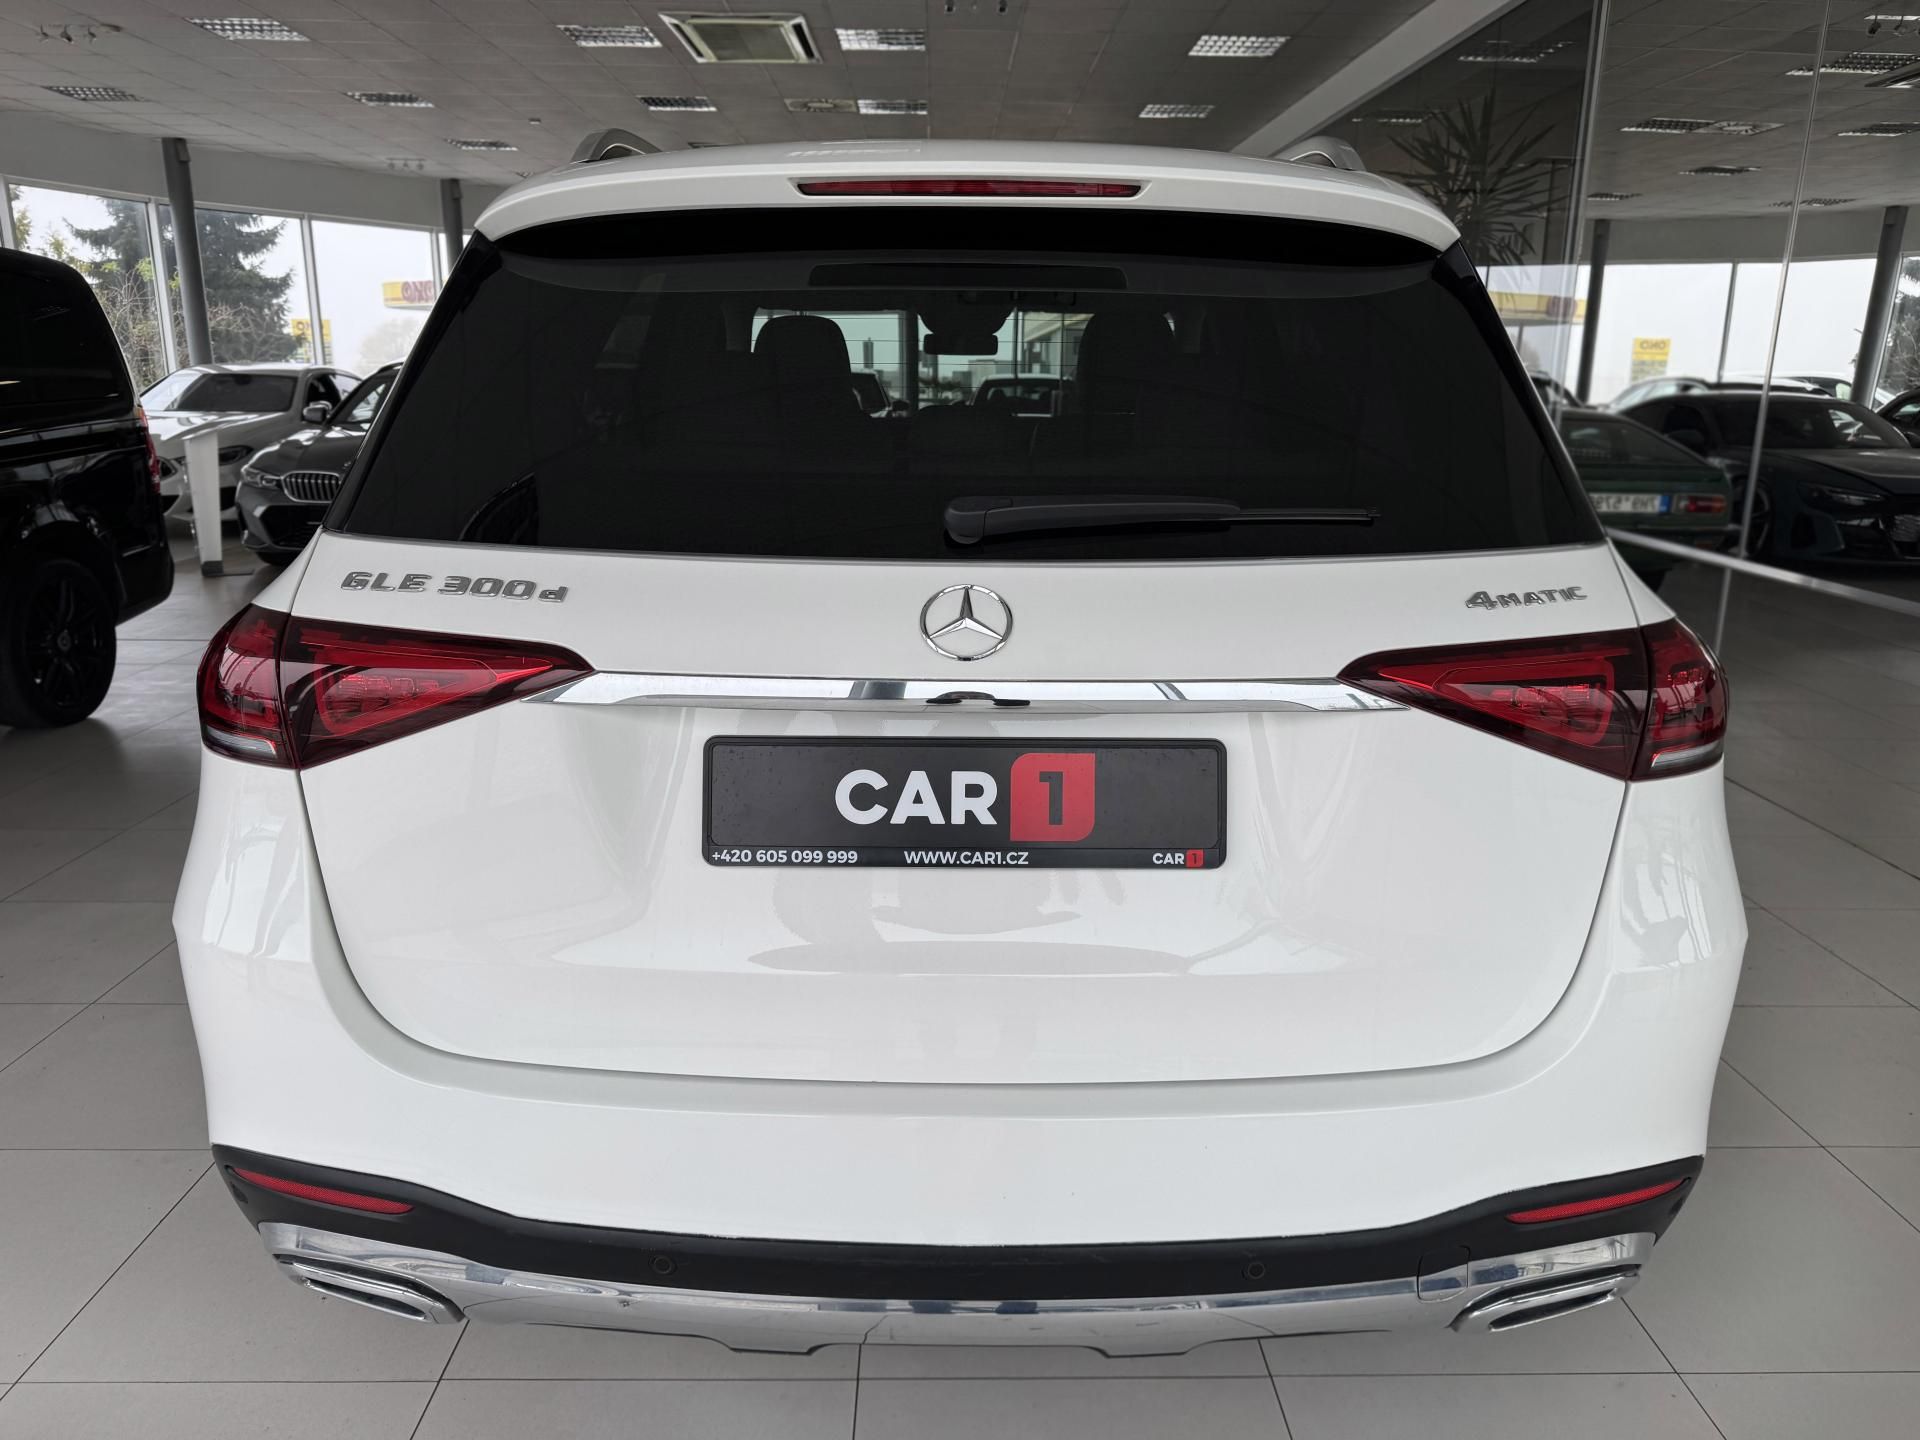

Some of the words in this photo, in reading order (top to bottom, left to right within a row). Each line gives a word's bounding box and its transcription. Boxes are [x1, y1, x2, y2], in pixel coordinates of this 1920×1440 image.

[341, 571, 432, 592] GLE
[437, 575, 569, 603] 300d
[1465, 586, 1588, 610] 4MATIC
[835, 768, 998, 825] CAR
[712, 849, 752, 863] +420
[756, 850, 787, 863] 605
[791, 850, 823, 864] 099
[826, 850, 858, 864] 999
[904, 850, 1029, 865] WWW.CAR1.CZ
[1152, 852, 1185, 865] CAR
